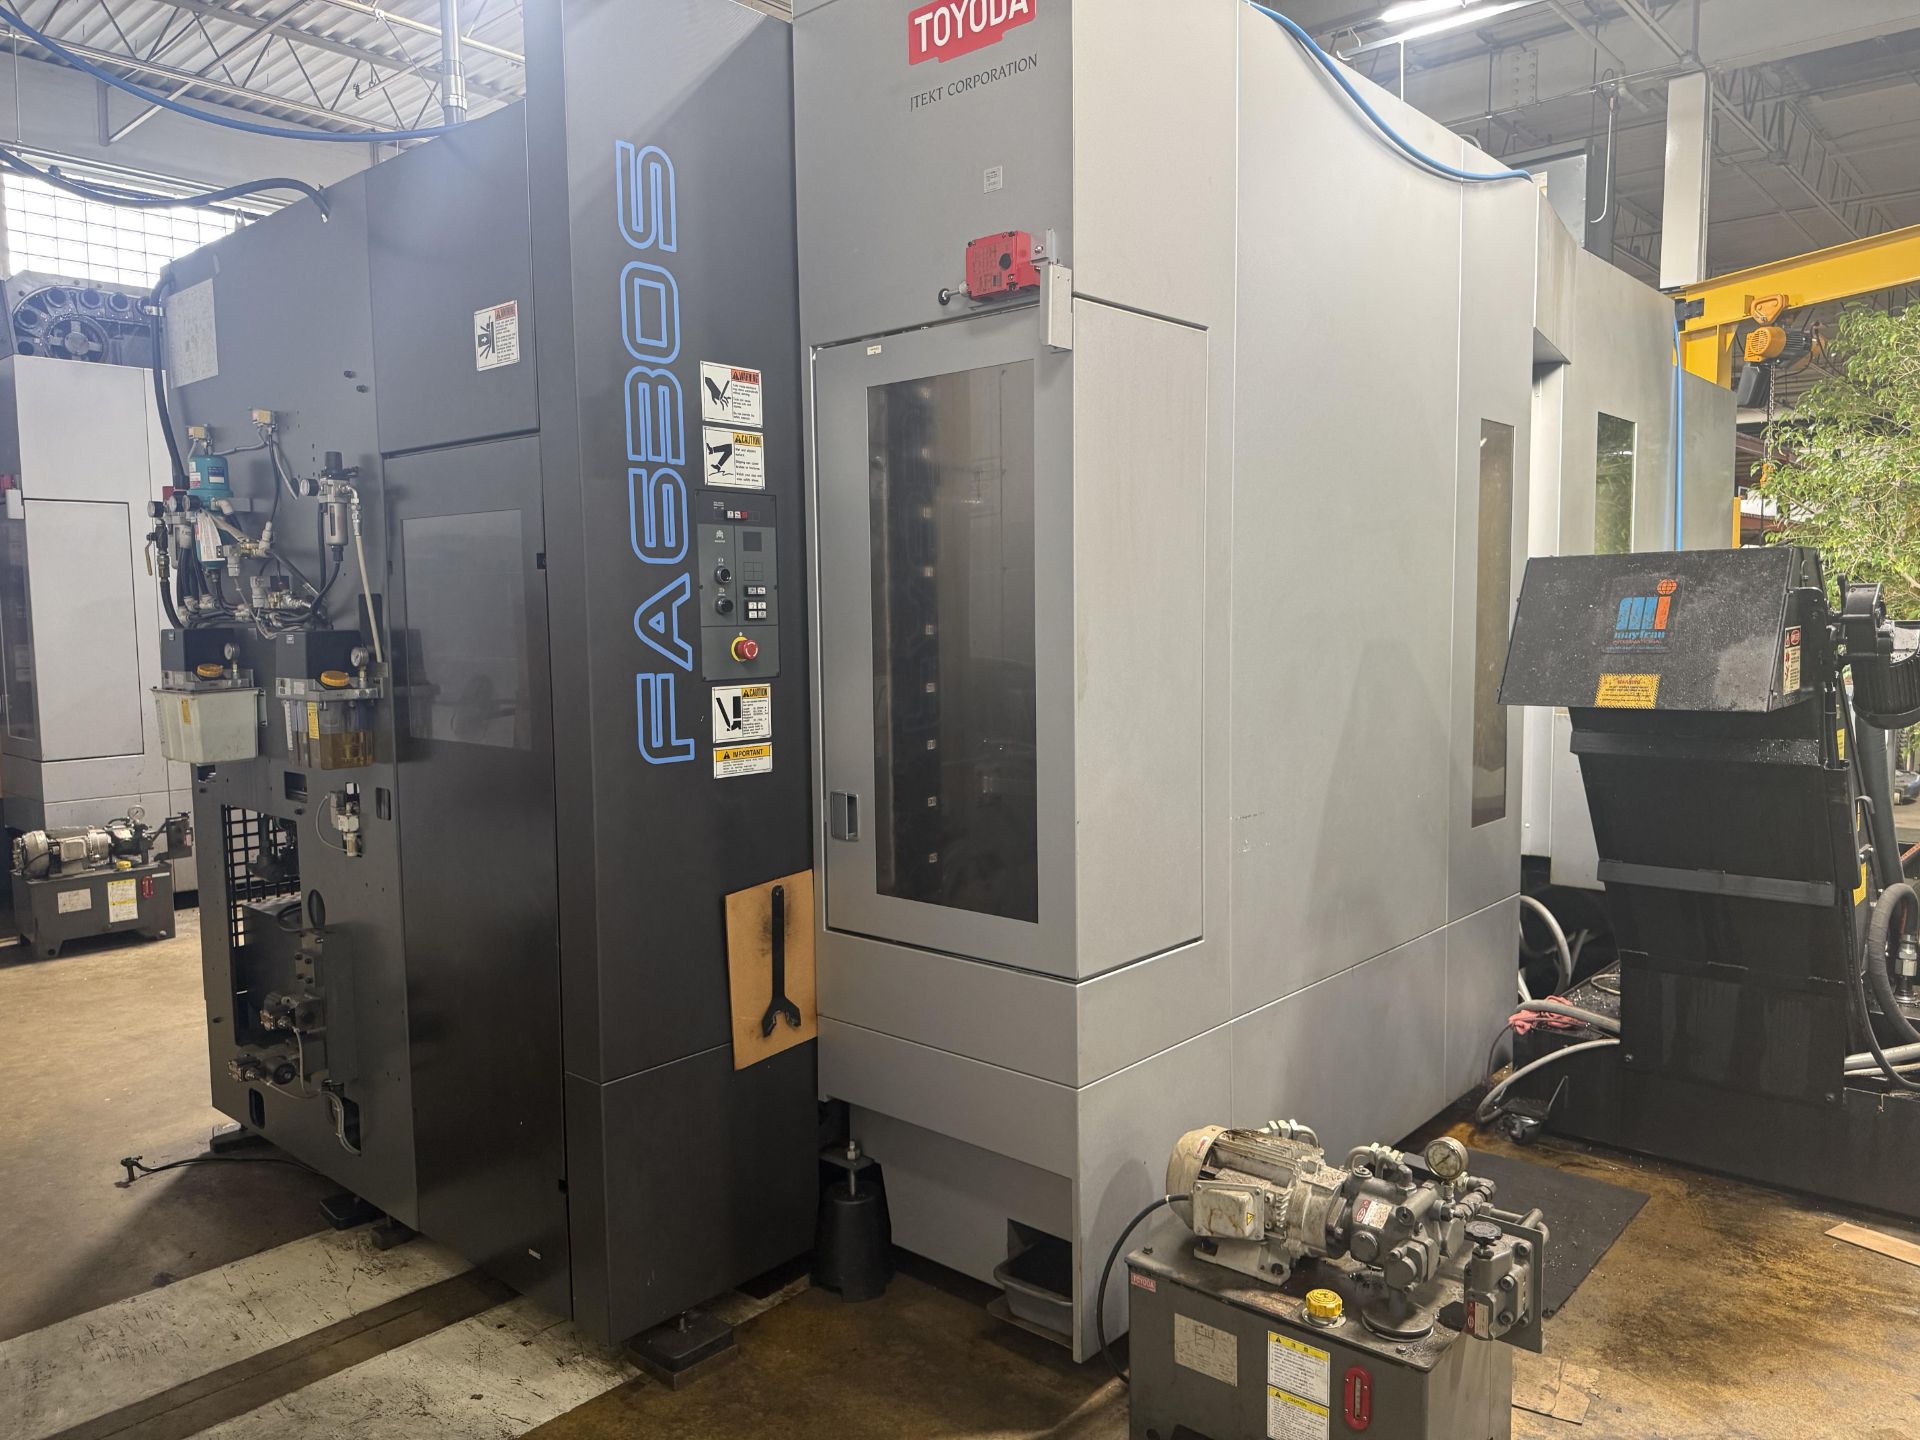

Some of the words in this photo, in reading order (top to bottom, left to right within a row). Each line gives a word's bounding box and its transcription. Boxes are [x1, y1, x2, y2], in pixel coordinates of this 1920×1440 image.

[910, 86, 944, 112] JTEKT
[947, 54, 1037, 97] CORPORATION
[615, 139, 694, 765] FA630S
[732, 749, 763, 758] IMPORTANT
